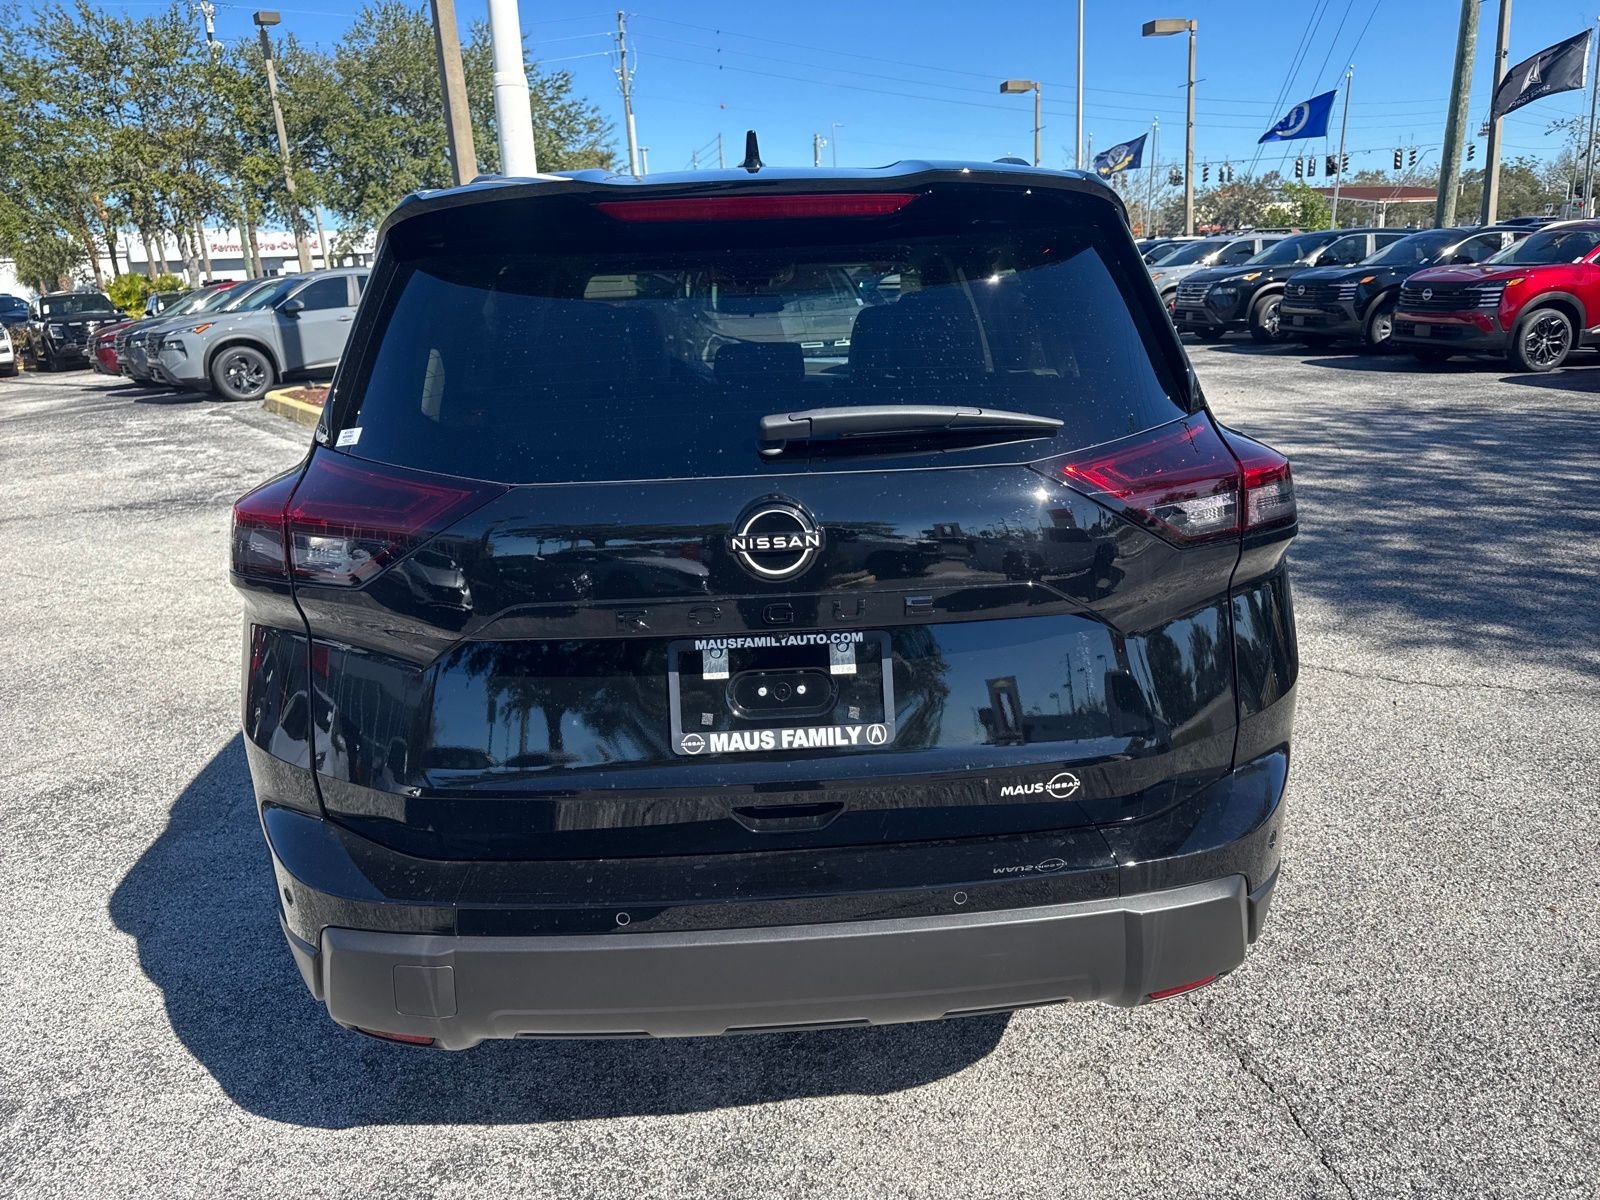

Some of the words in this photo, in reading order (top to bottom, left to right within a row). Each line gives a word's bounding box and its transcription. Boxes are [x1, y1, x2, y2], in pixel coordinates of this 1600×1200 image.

[731, 532, 820, 550] NISSAN
[615, 595, 936, 632] ROGUE
[694, 631, 864, 651] MAUSFAMILYAUTO.COM
[709, 730, 776, 752] MAUS
[781, 726, 863, 749] FAMILY
[1000, 782, 1044, 797] MAUS
[1045, 778, 1081, 790] NISSAN
